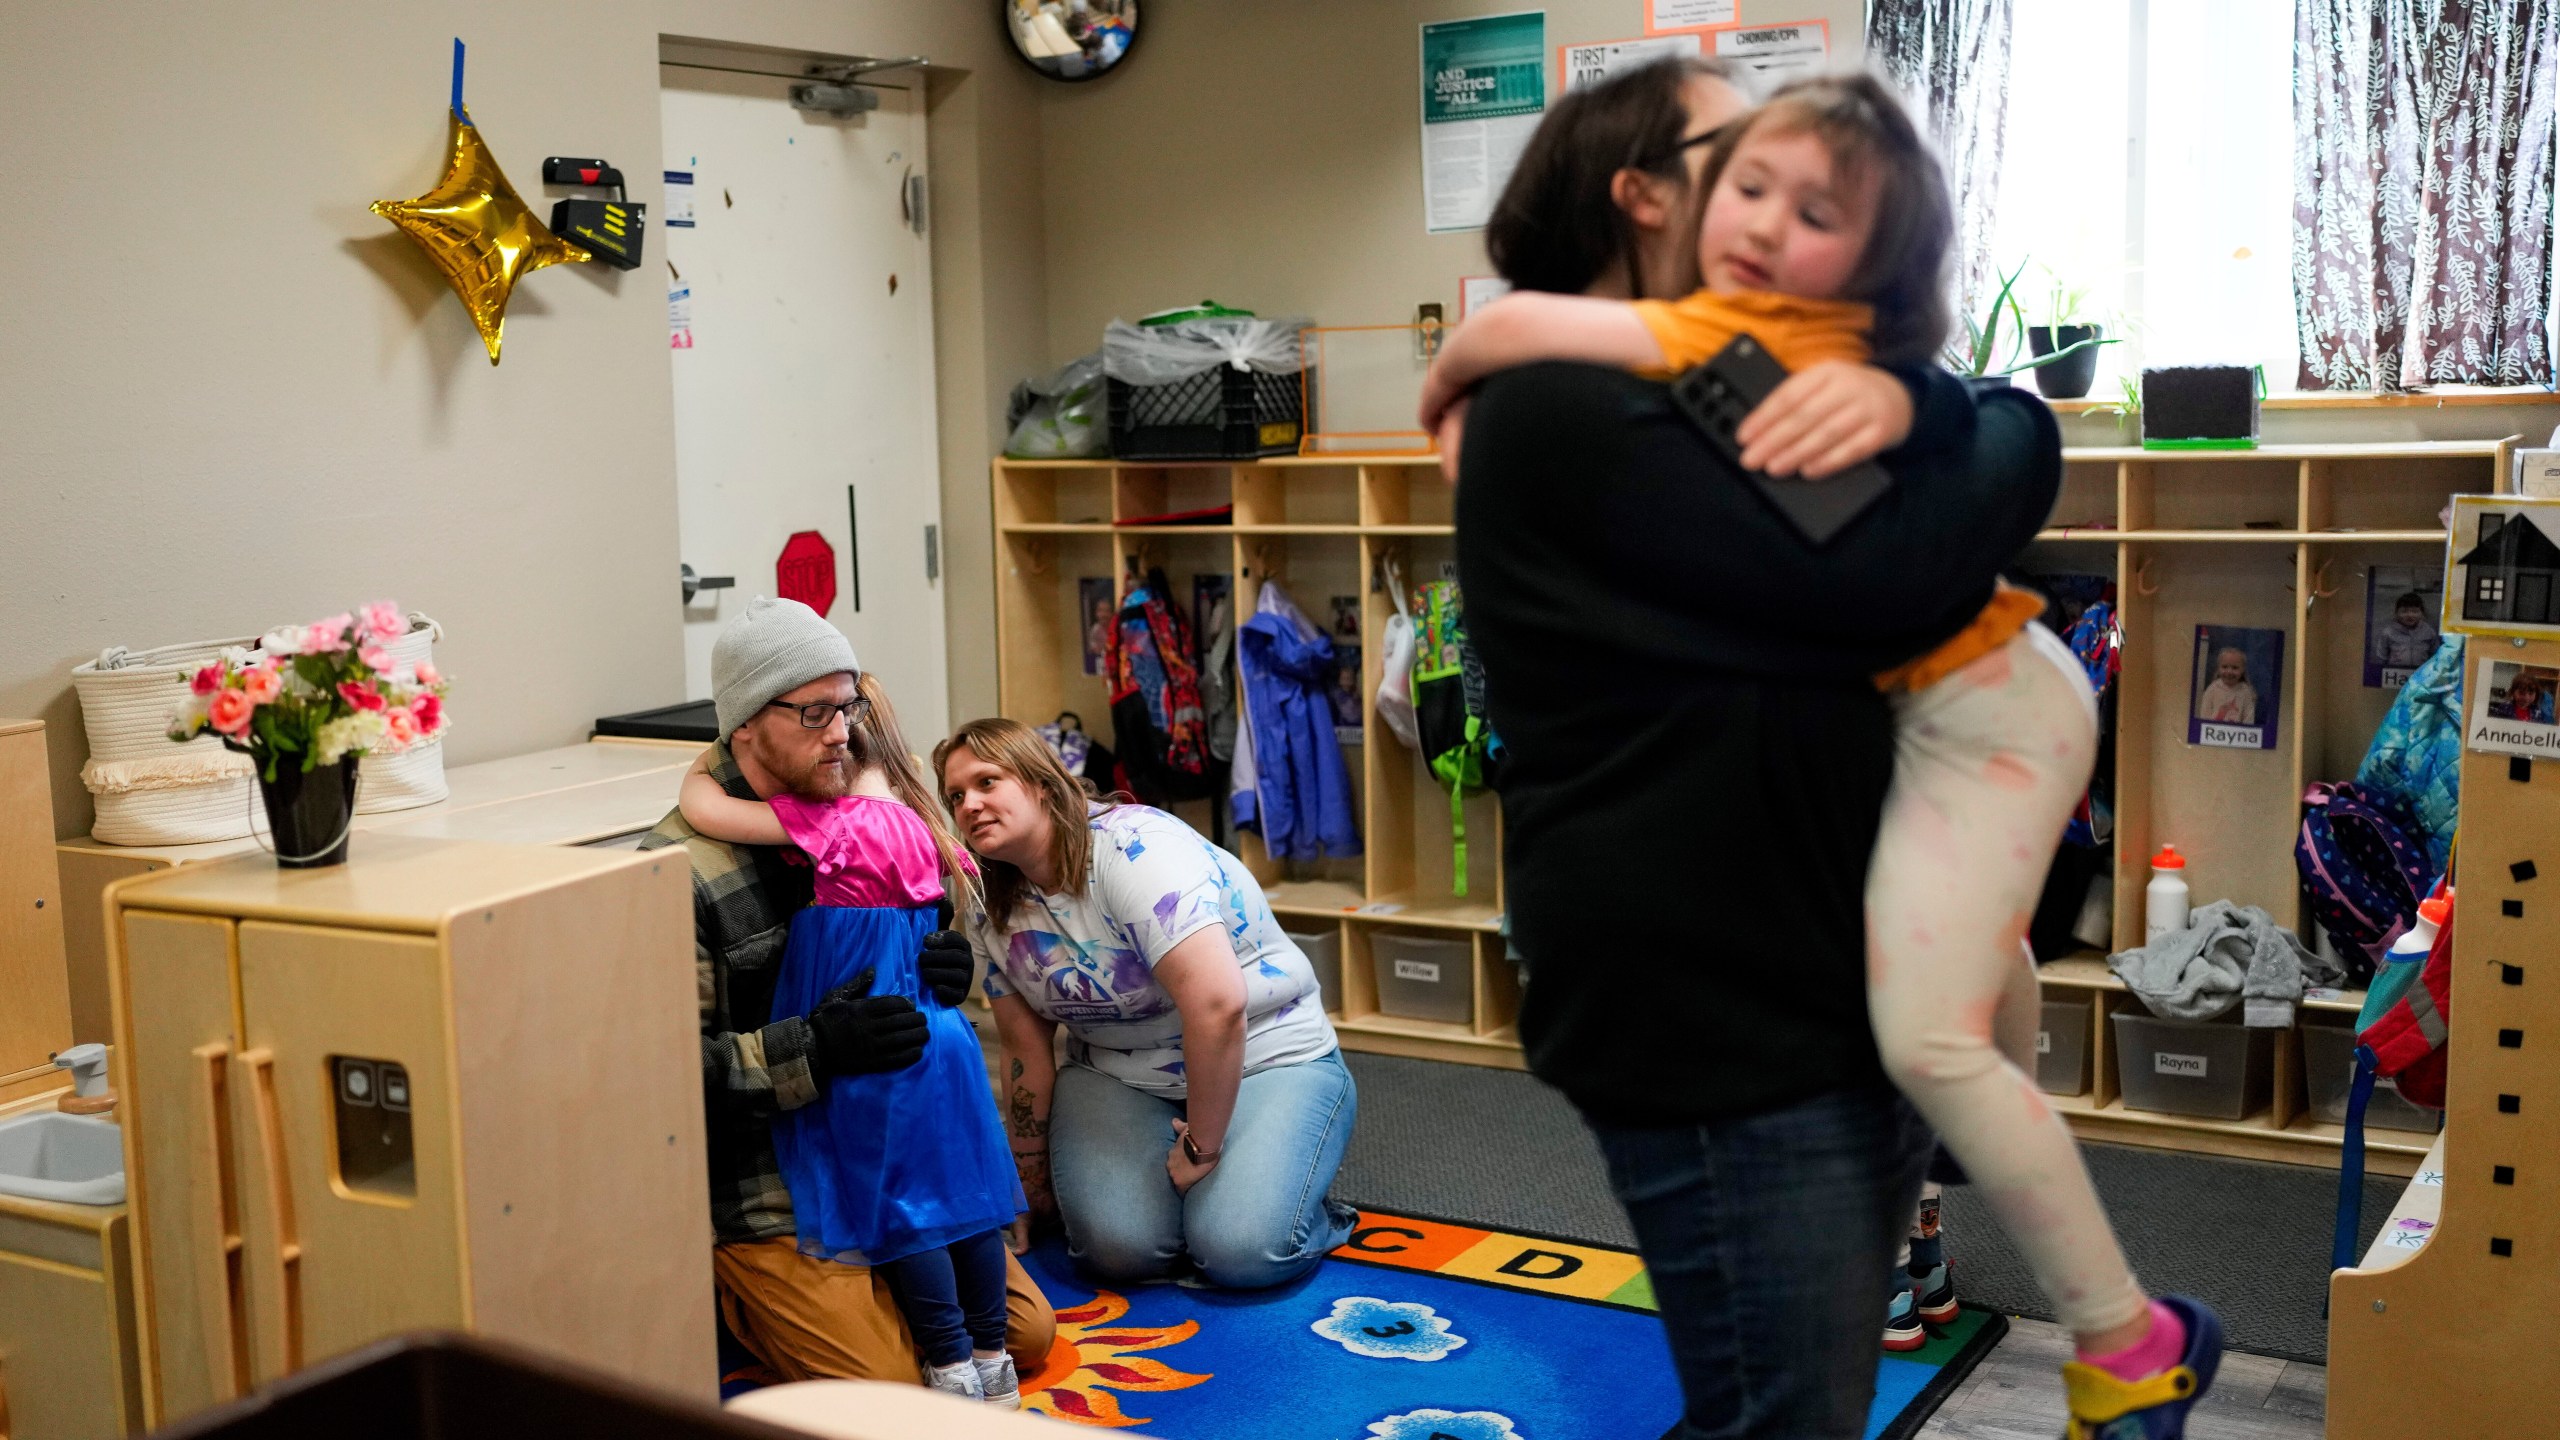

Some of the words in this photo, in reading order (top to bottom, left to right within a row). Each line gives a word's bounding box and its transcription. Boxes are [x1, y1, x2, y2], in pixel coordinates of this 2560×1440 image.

[1736, 28, 1800, 46] CHOKING/CPR
[1573, 47, 1606, 67] FIRST
[1435, 68, 1466, 83] AND
[1435, 76, 1496, 94] JUSTICE
[1451, 91, 1480, 105] ALL
[783, 553, 831, 602] STOP
[2205, 727, 2258, 745] Rayna
[1056, 1006, 1118, 1015] ADVENTURE
[2160, 1055, 2199, 1070] Rayna
[1349, 1226, 1425, 1253] C
[1495, 1248, 1583, 1279] D
[1362, 1321, 1416, 1338] 3
